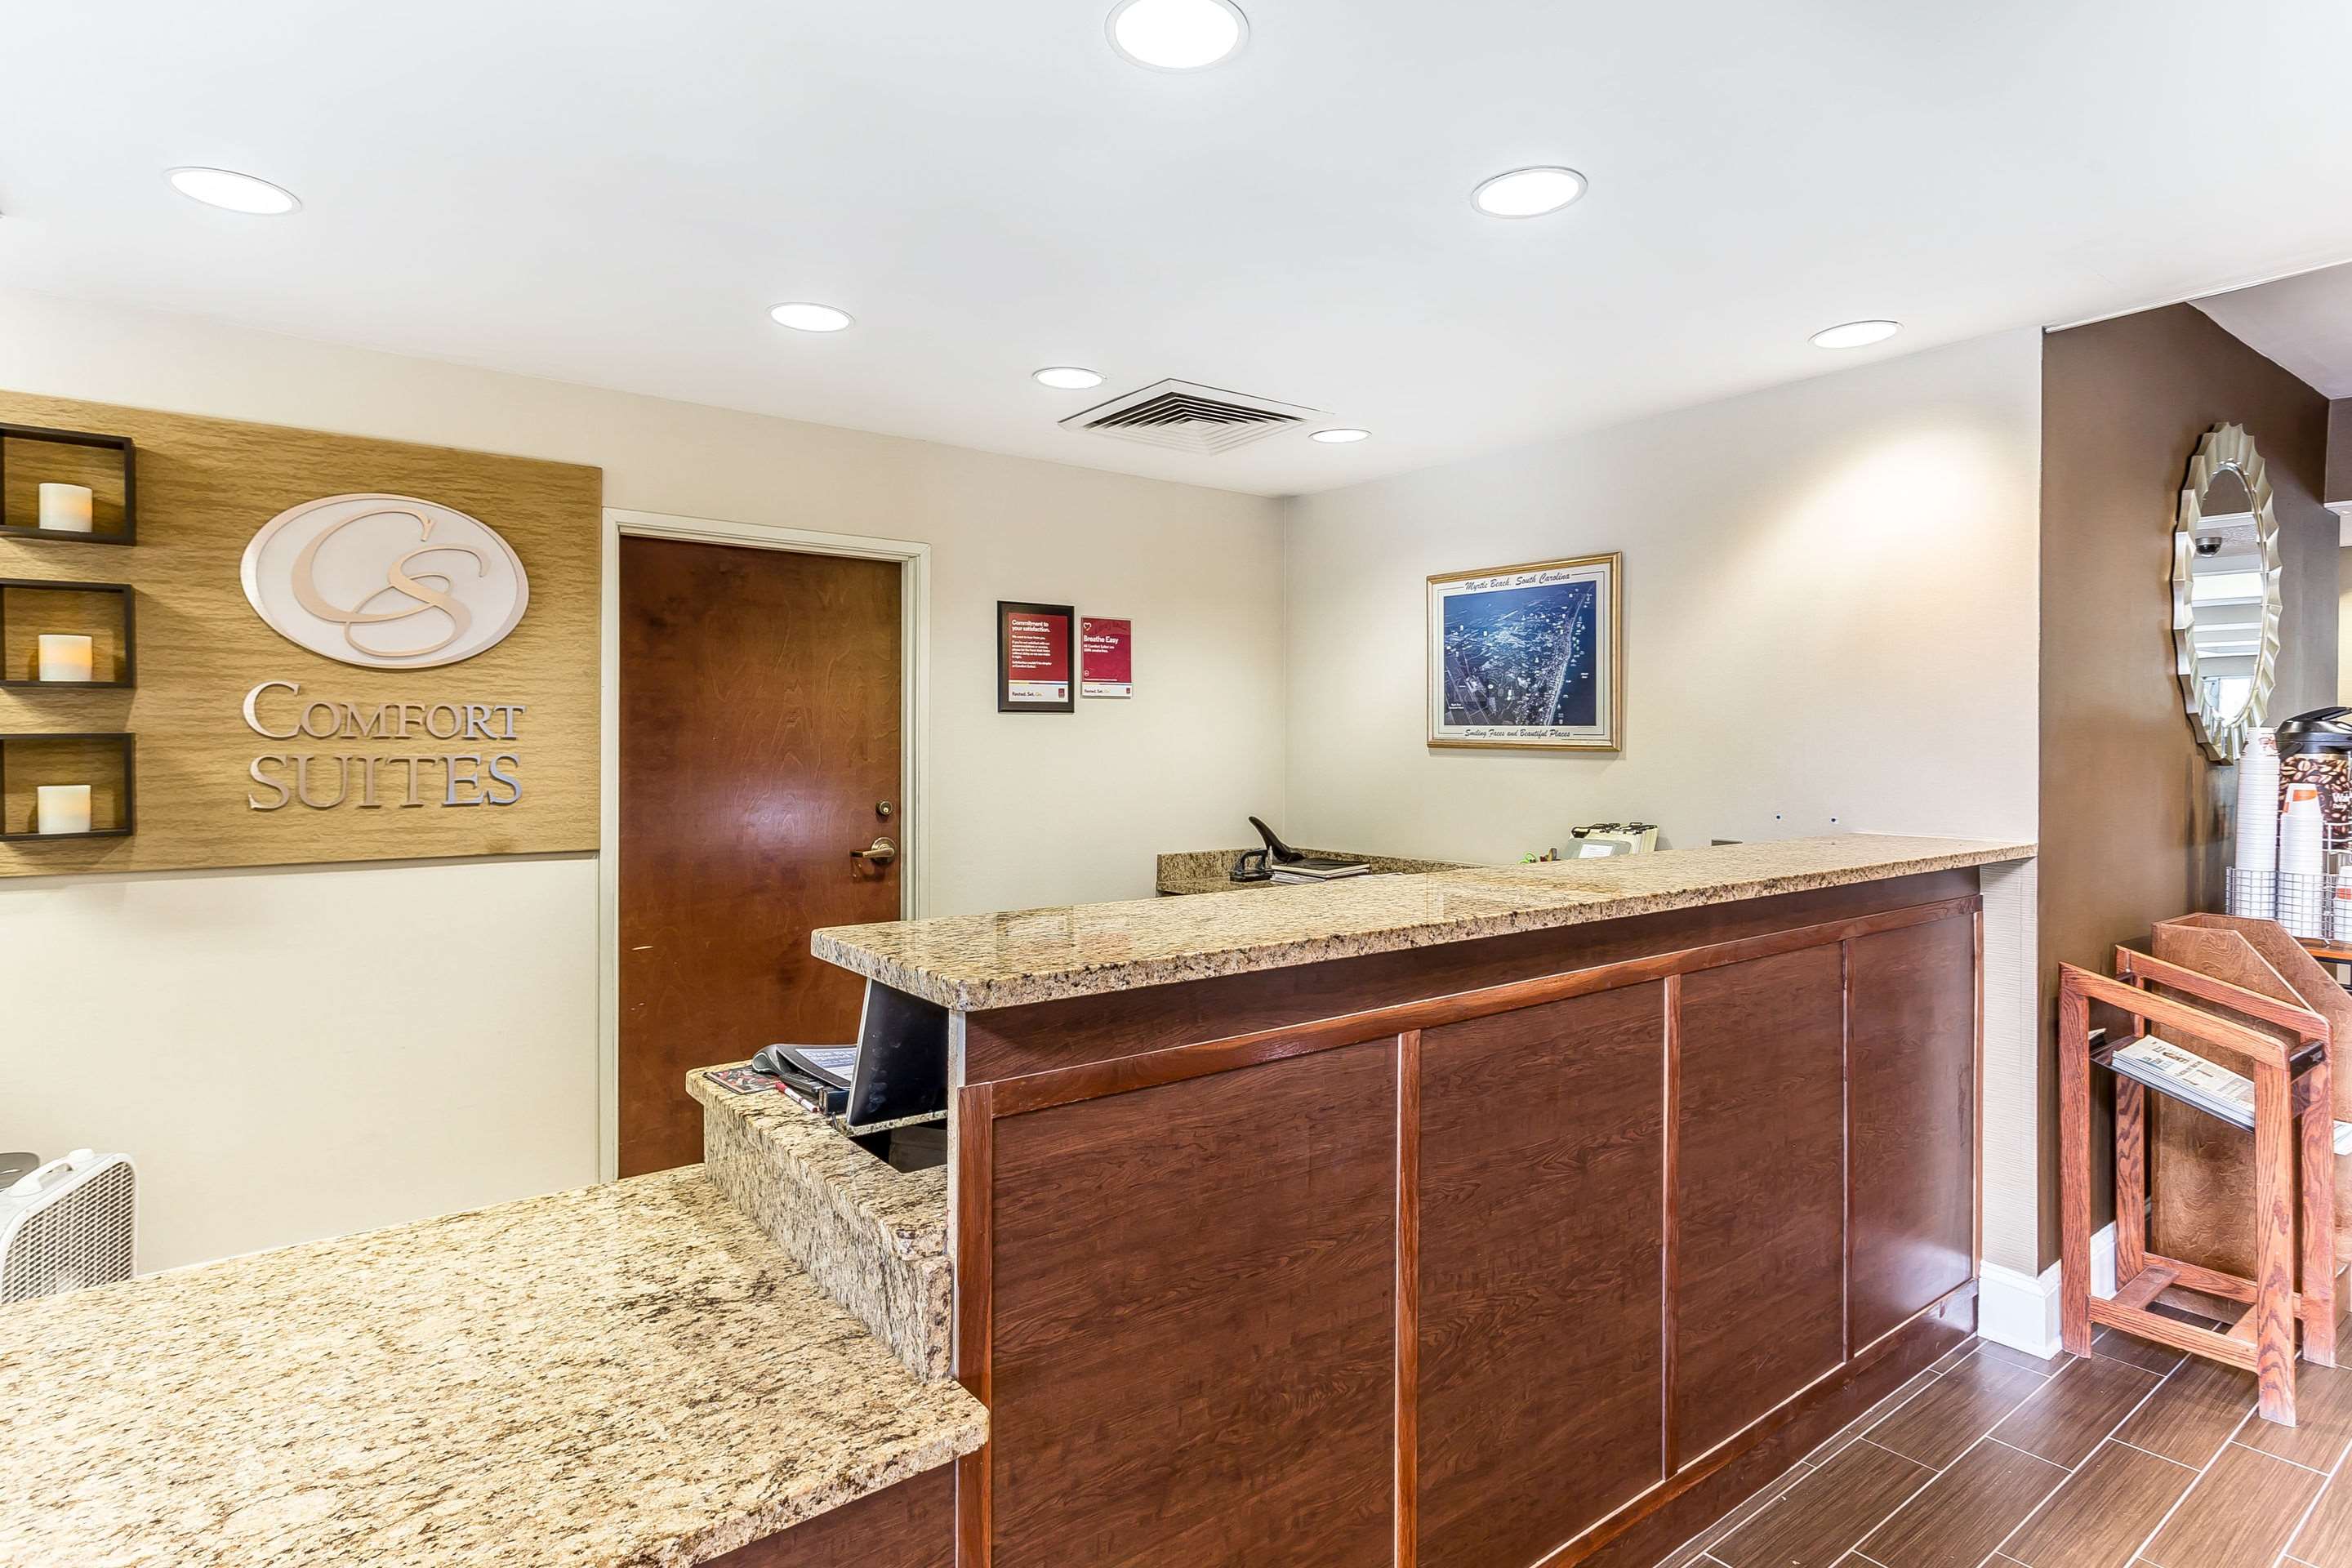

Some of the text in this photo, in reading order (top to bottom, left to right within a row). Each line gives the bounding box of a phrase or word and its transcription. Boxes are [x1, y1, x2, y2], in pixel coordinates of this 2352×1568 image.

[1465, 581, 1488, 591] Myrtle
[1515, 575, 1536, 586] South
[1539, 572, 1570, 584] Carolina
[1084, 635, 1119, 644] Breathe Easy
[1465, 728, 1487, 738] Smiling
[1488, 728, 1505, 737] Faces
[1519, 728, 1548, 738] Beautiful
[1549, 728, 1570, 737] Places
[247, 754, 523, 813] SUITES
